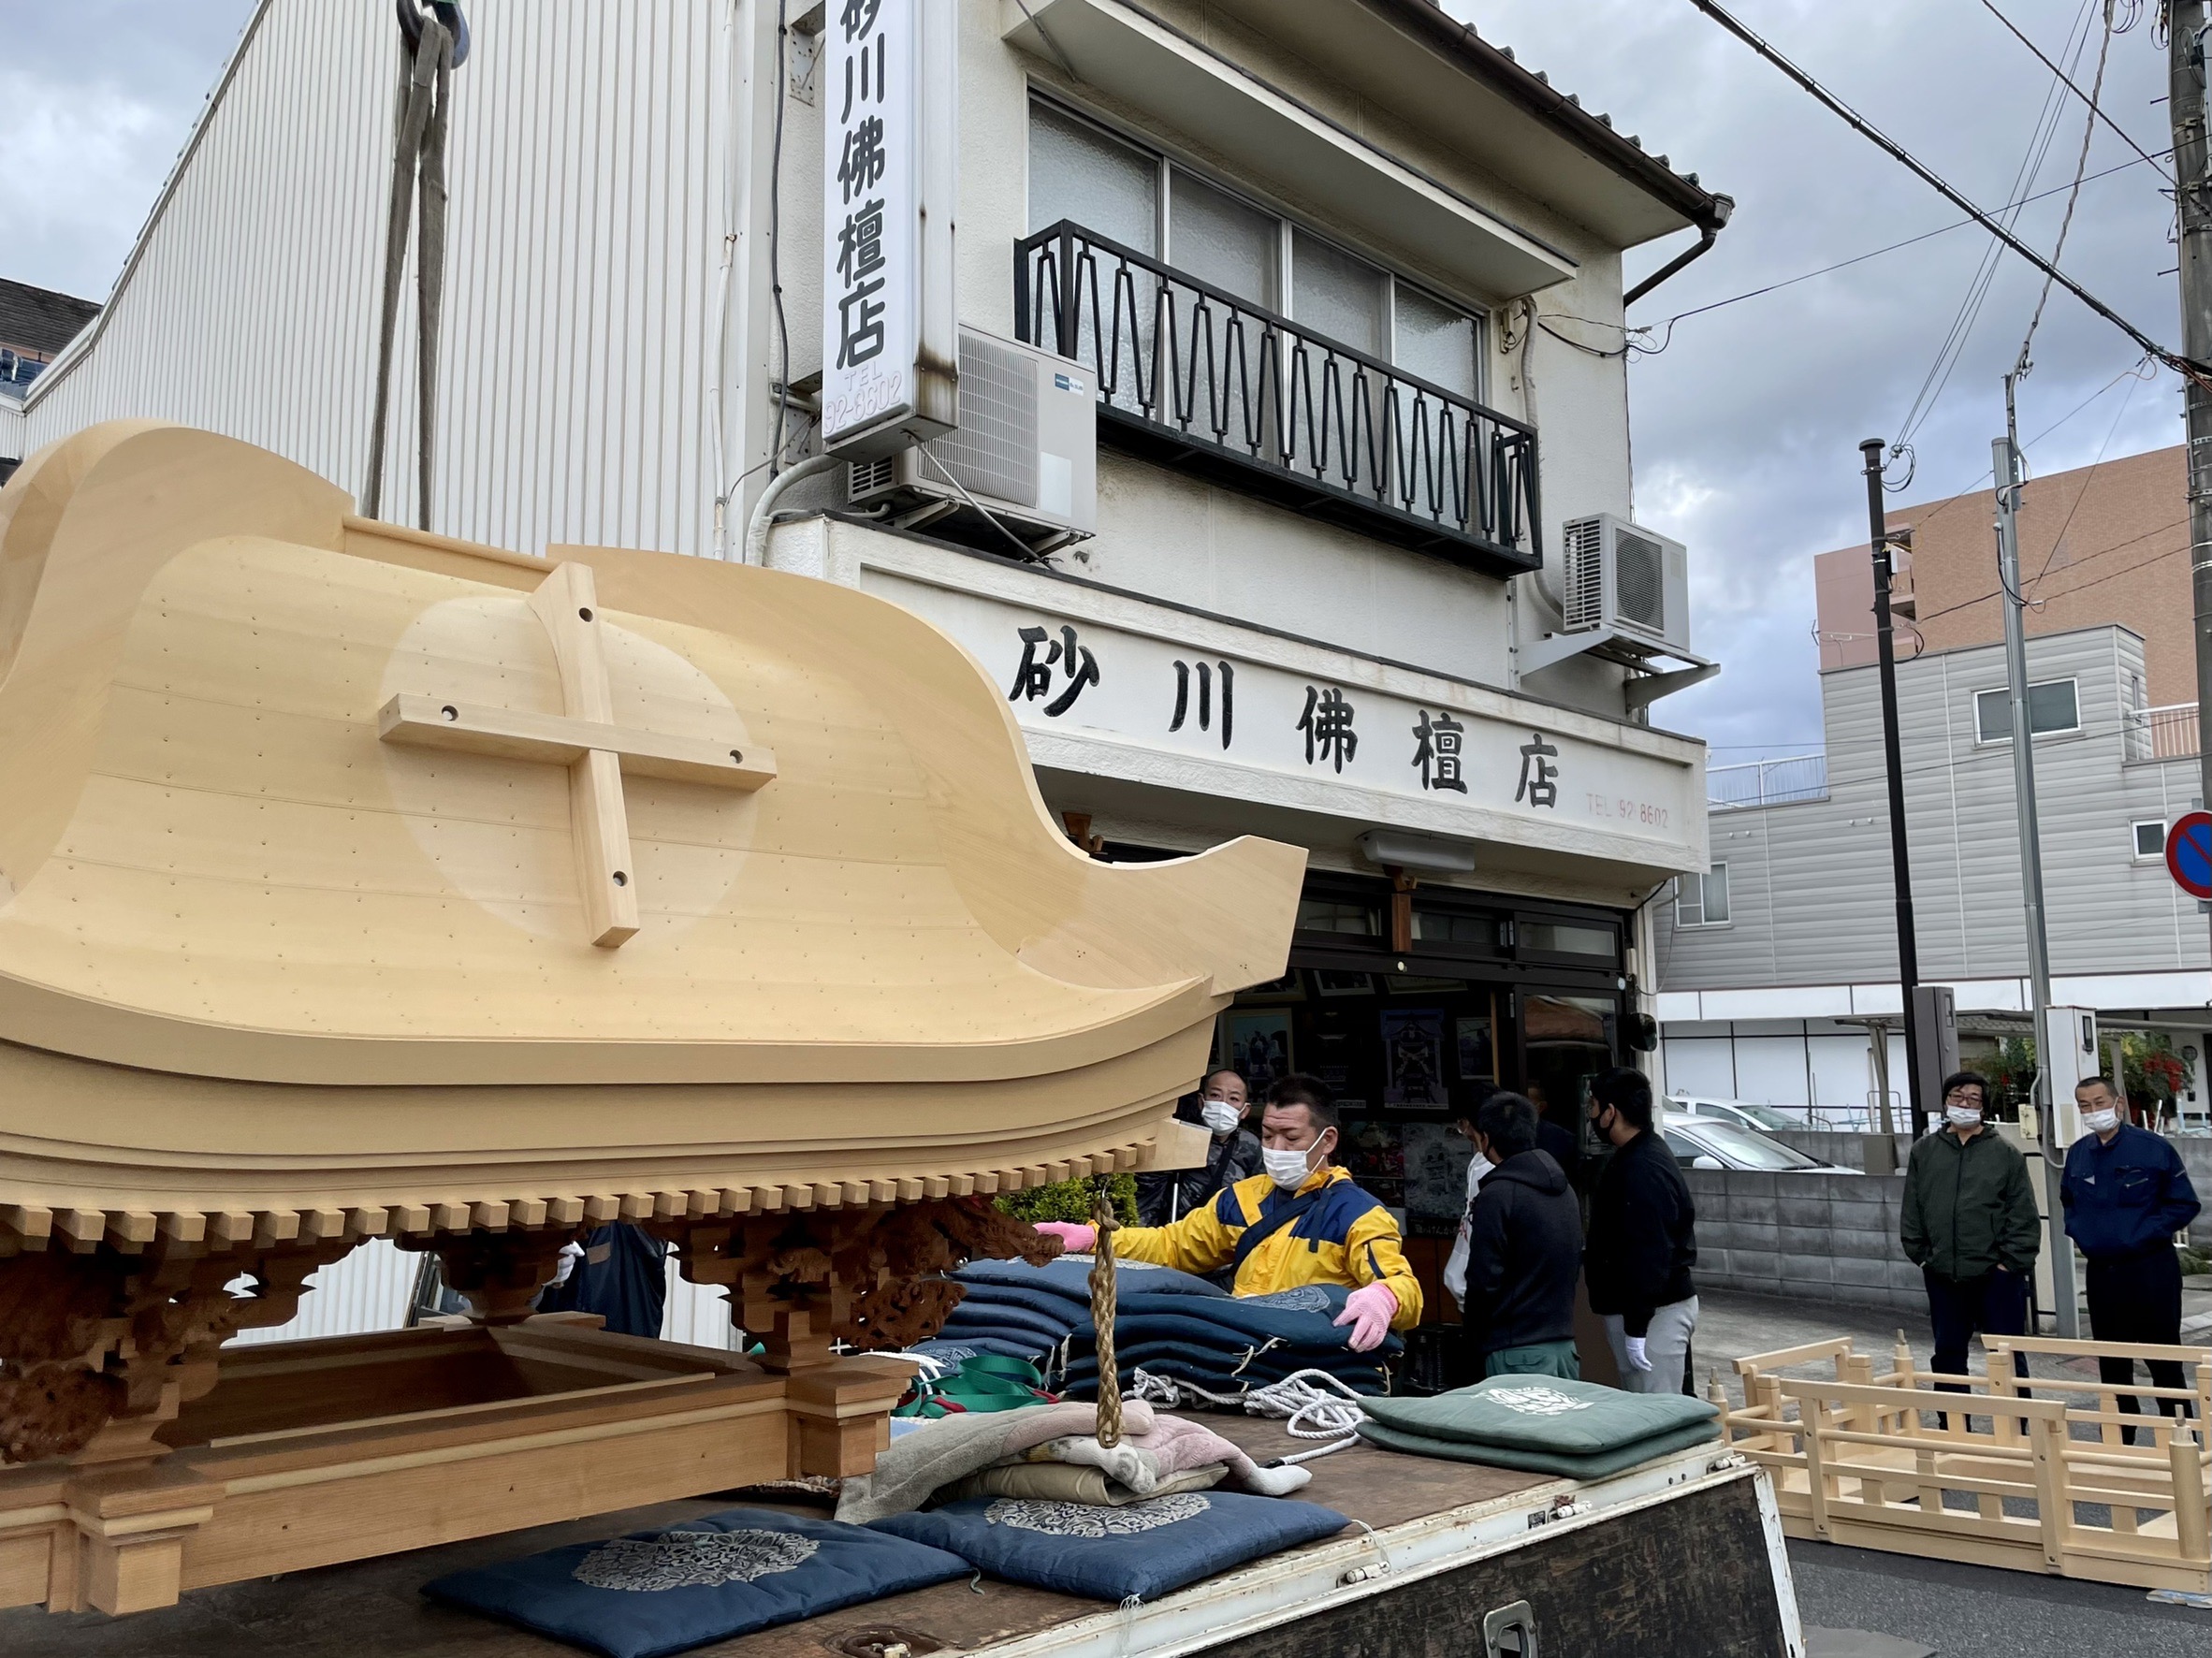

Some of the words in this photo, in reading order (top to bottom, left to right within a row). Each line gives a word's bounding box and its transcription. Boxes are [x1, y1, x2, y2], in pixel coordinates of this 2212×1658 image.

[844, 361, 882, 391] TEL
[823, 371, 903, 434] 92-8602
[1586, 793, 1613, 817] TEL
